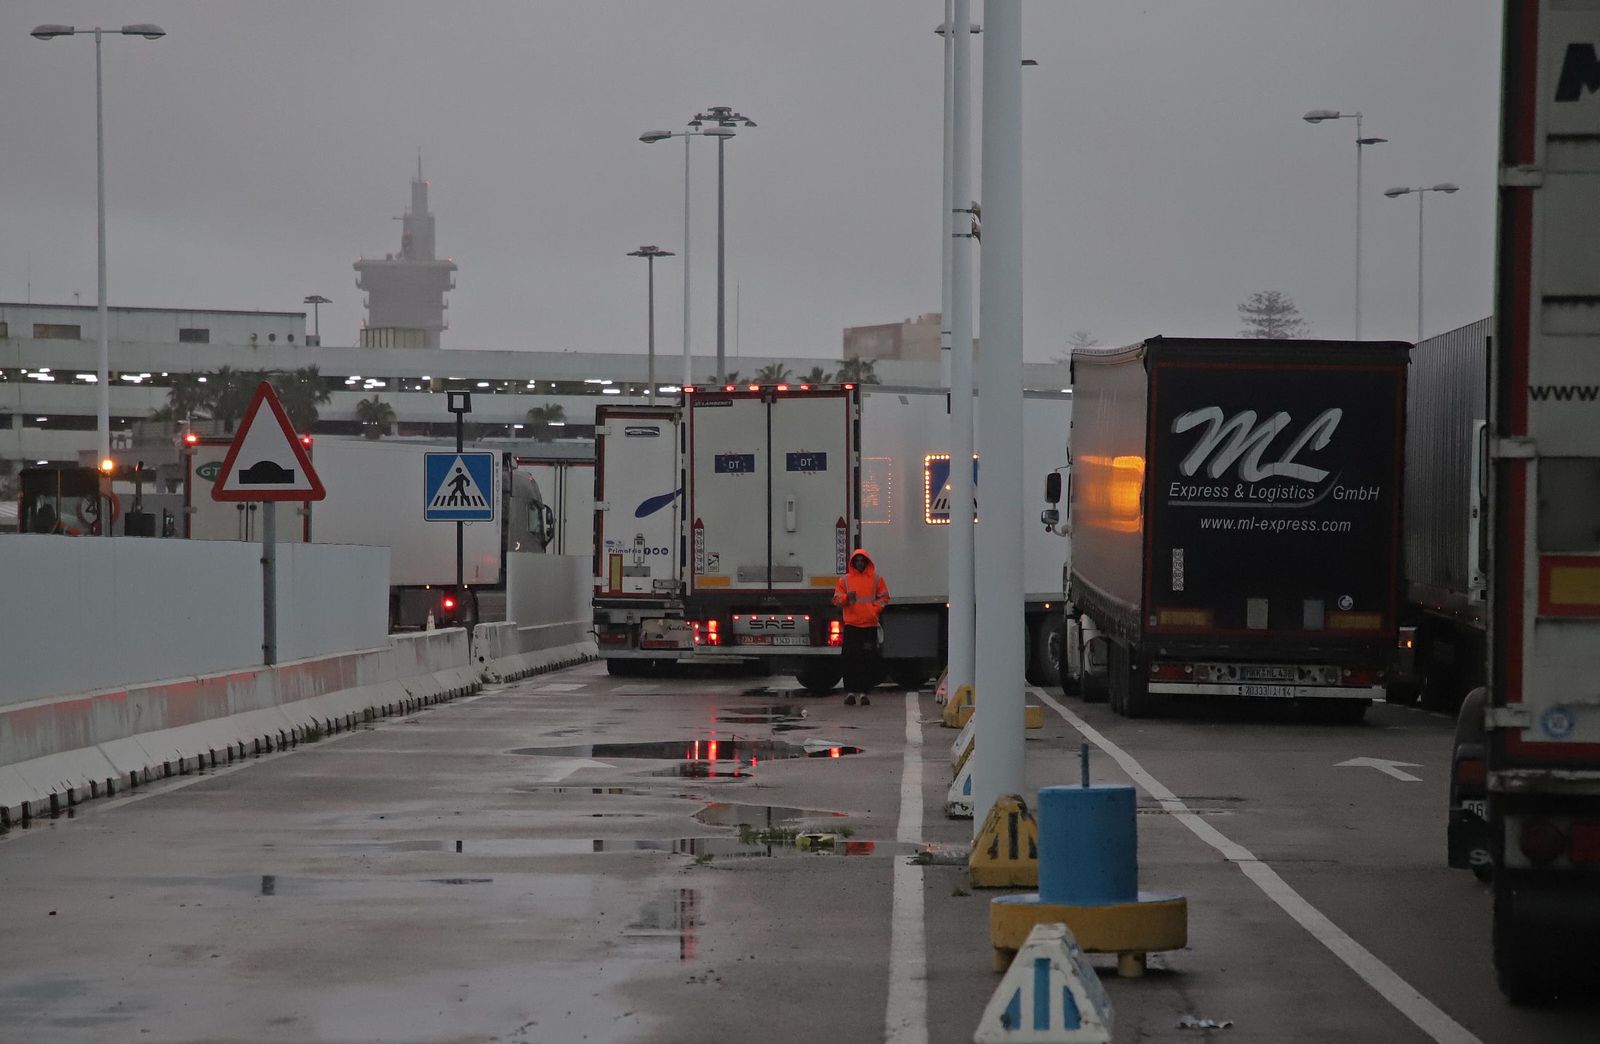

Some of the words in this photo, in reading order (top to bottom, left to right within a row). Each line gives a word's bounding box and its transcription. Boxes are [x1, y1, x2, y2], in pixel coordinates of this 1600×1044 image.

[1171, 405, 1343, 483] ML
[728, 460, 740, 470] DT
[800, 458, 812, 467] DT
[1169, 482, 1229, 499] Express
[1234, 483, 1245, 498] &
[1249, 484, 1315, 503] Logistics
[1333, 485, 1380, 501] GmbH
[1200, 516, 1352, 534] www.ml-express.com
